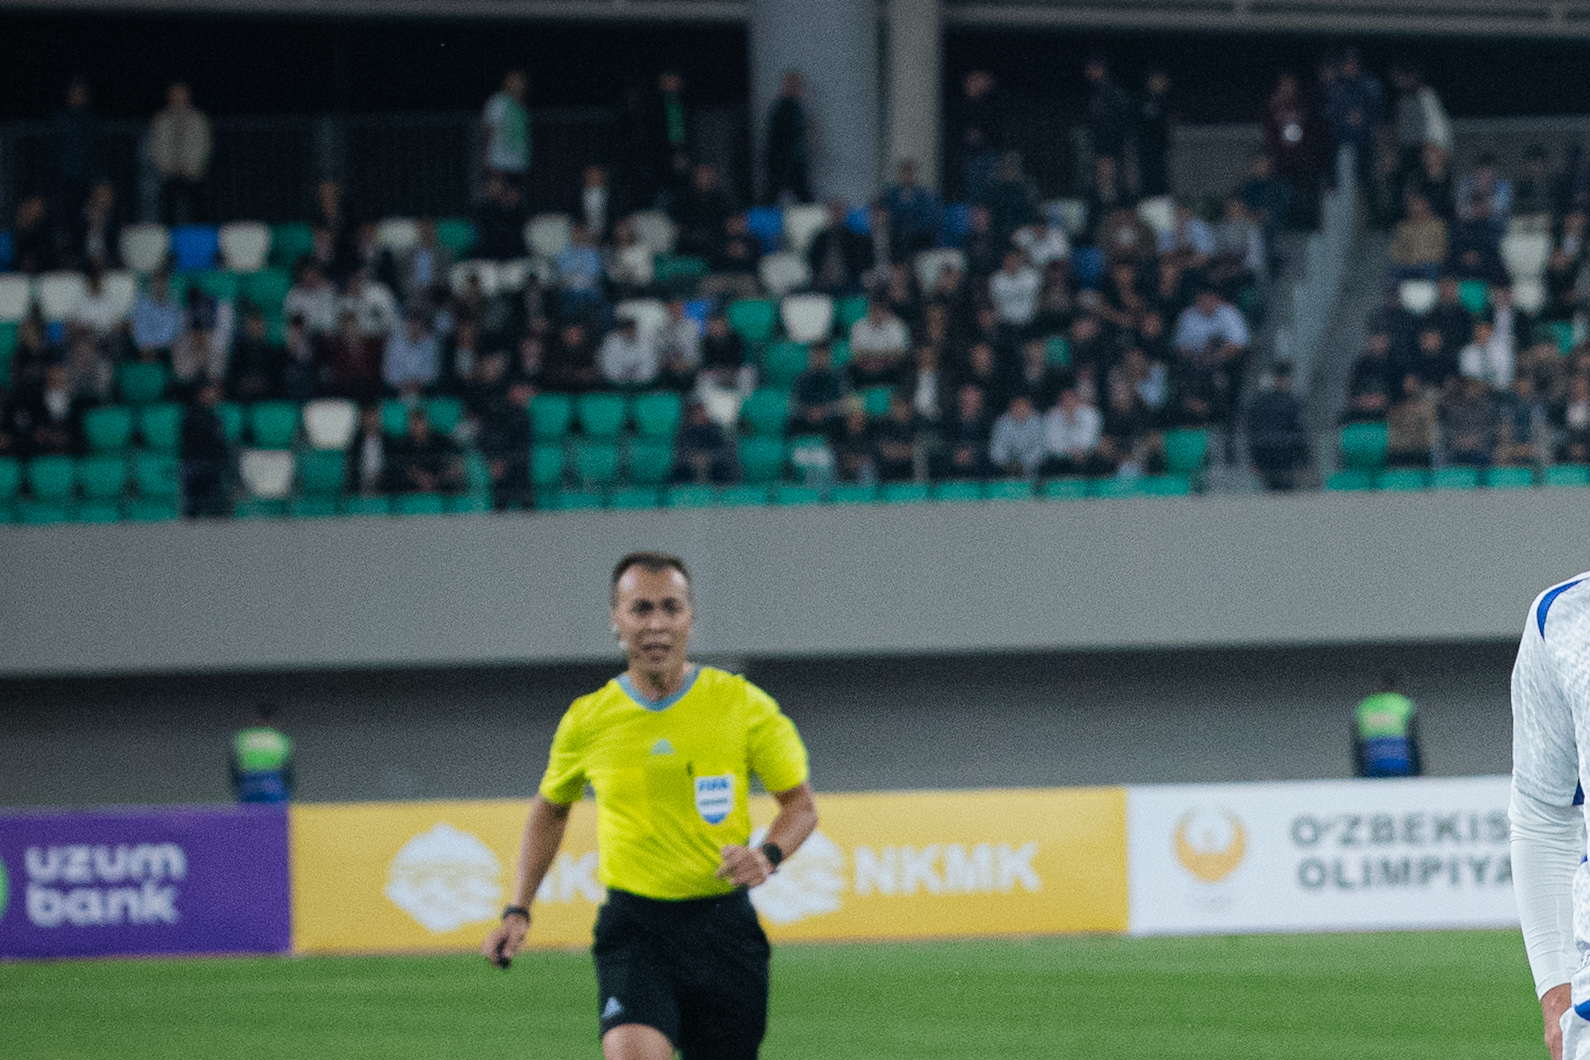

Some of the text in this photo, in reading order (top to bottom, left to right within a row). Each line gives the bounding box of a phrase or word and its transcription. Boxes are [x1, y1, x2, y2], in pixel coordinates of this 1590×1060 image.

[698, 779, 729, 791] FIFA
[24, 843, 188, 882] uzum
[854, 840, 1042, 896] NKMK
[25, 882, 180, 928] bank
